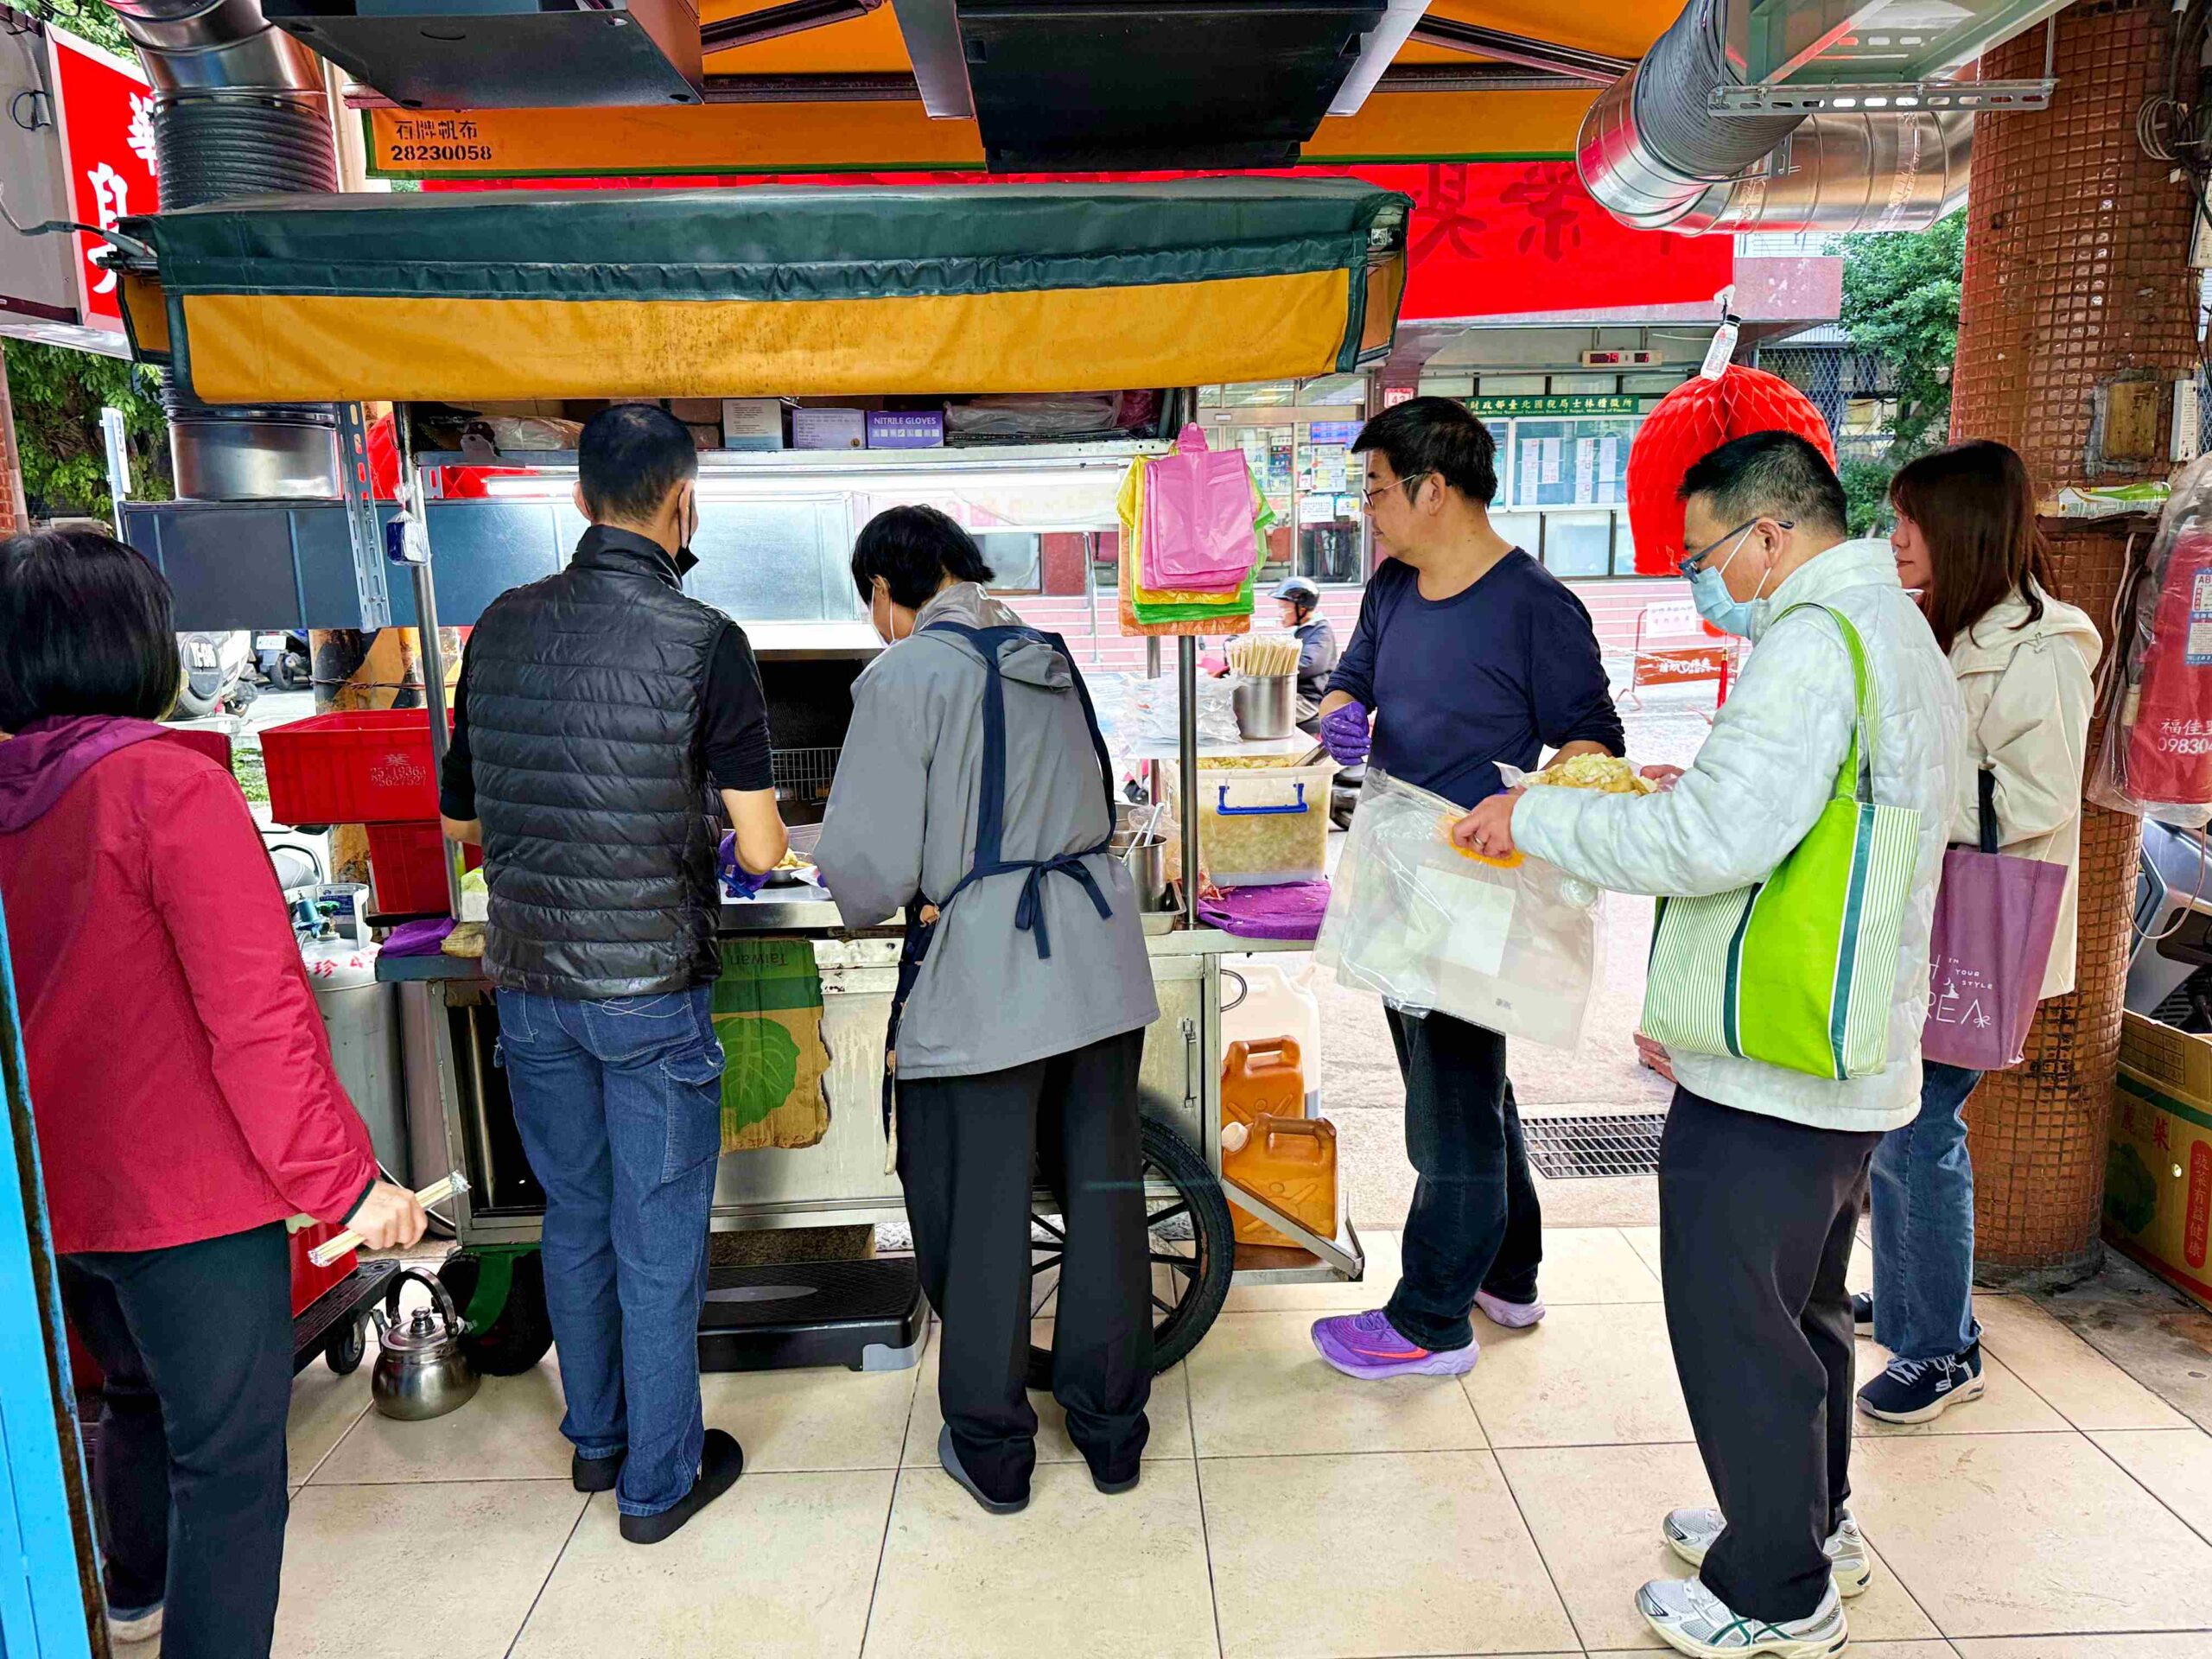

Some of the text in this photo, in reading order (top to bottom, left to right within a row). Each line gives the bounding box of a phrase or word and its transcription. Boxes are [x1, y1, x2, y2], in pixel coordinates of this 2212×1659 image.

[394, 120, 477, 140] 石牌帆布
[391, 145, 492, 161] 28230058
[874, 416, 937, 425] NITRILE GLOVES
[731, 953, 789, 969] Taiwan
[1955, 968, 1980, 977] YOUR
[1961, 980, 1993, 990] STYLE
